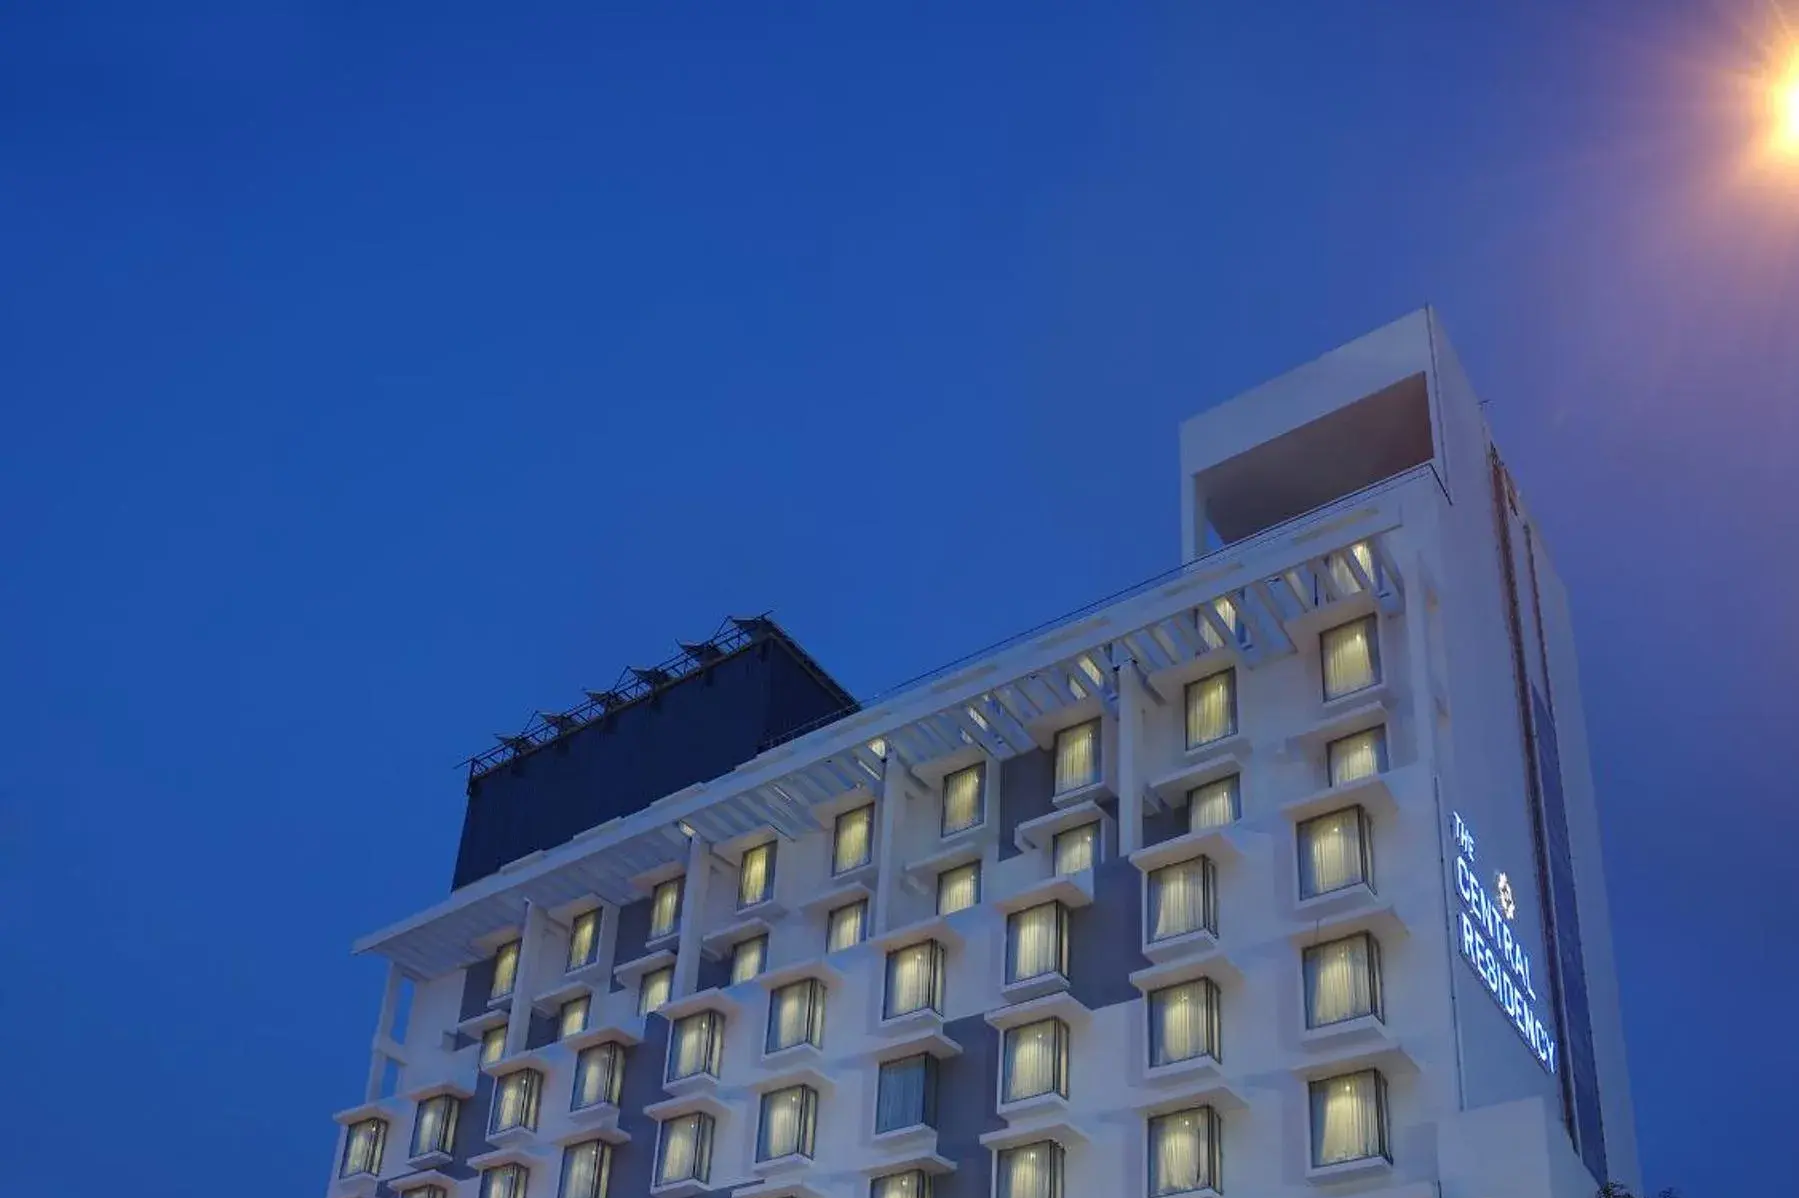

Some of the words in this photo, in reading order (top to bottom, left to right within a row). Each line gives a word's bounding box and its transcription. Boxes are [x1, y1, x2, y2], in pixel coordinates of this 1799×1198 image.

[1453, 811, 1475, 861] THE
[1457, 856, 1536, 1000] CENTRAL
[1462, 912, 1555, 1073] RESIDENCY
